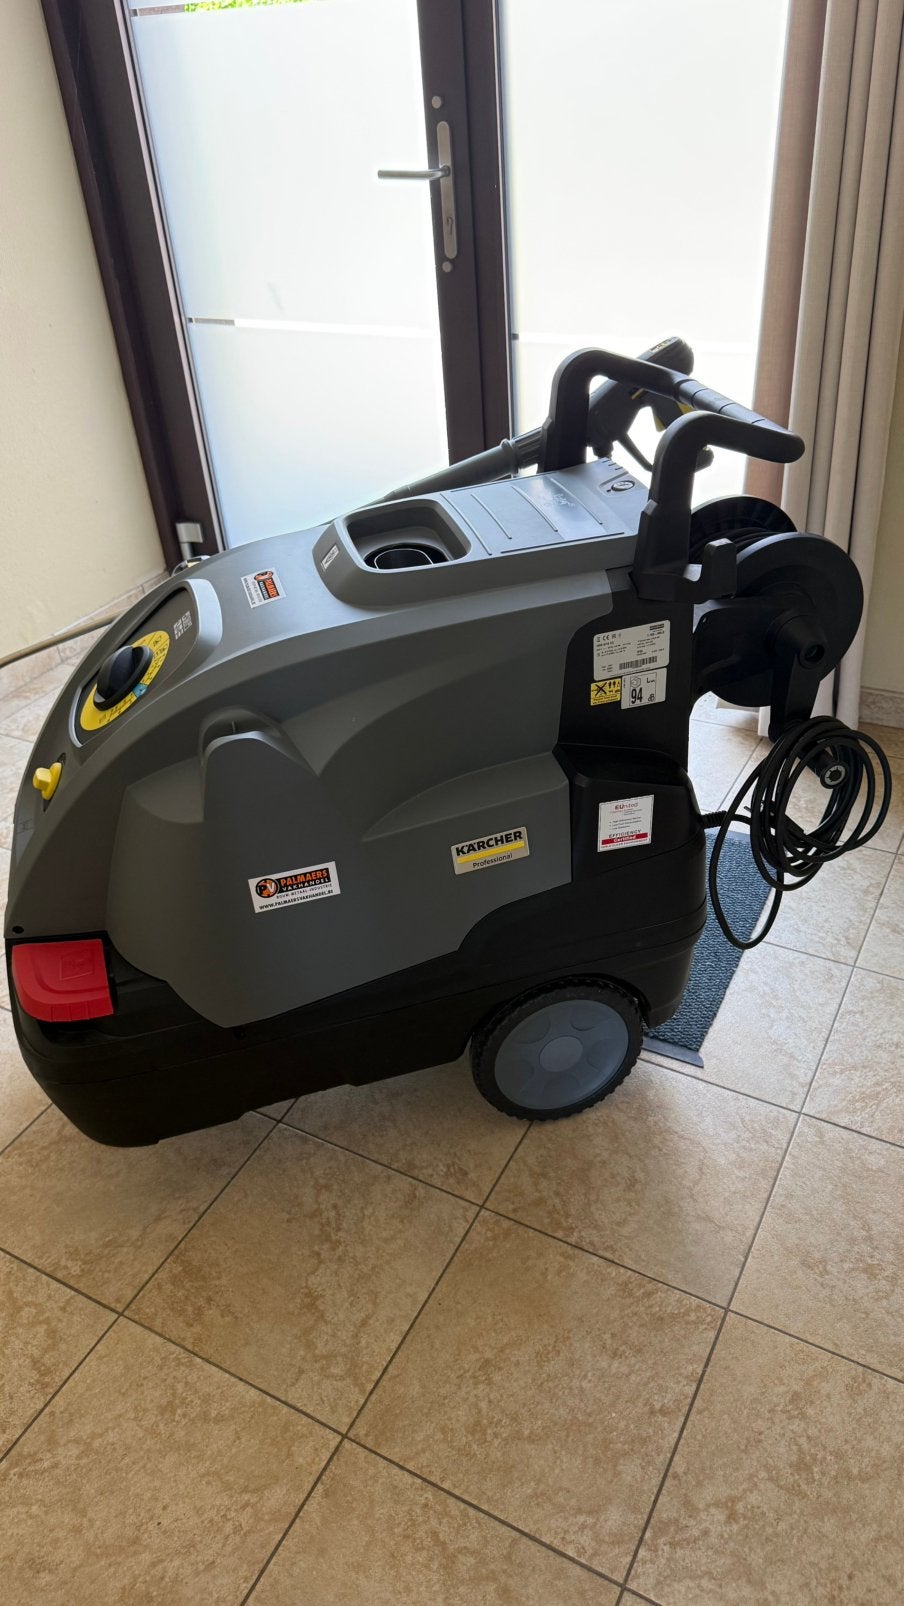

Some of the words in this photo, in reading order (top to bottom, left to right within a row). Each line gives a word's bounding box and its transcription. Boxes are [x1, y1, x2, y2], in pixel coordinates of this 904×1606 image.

[631, 687, 643, 704] 94
[609, 829, 641, 838] EFFICIENCY
[455, 830, 523, 856] KÄRCHER
[472, 853, 513, 868] Professional
[281, 869, 328, 887] PALMAERS
[282, 878, 329, 891] VAKHANDEL
